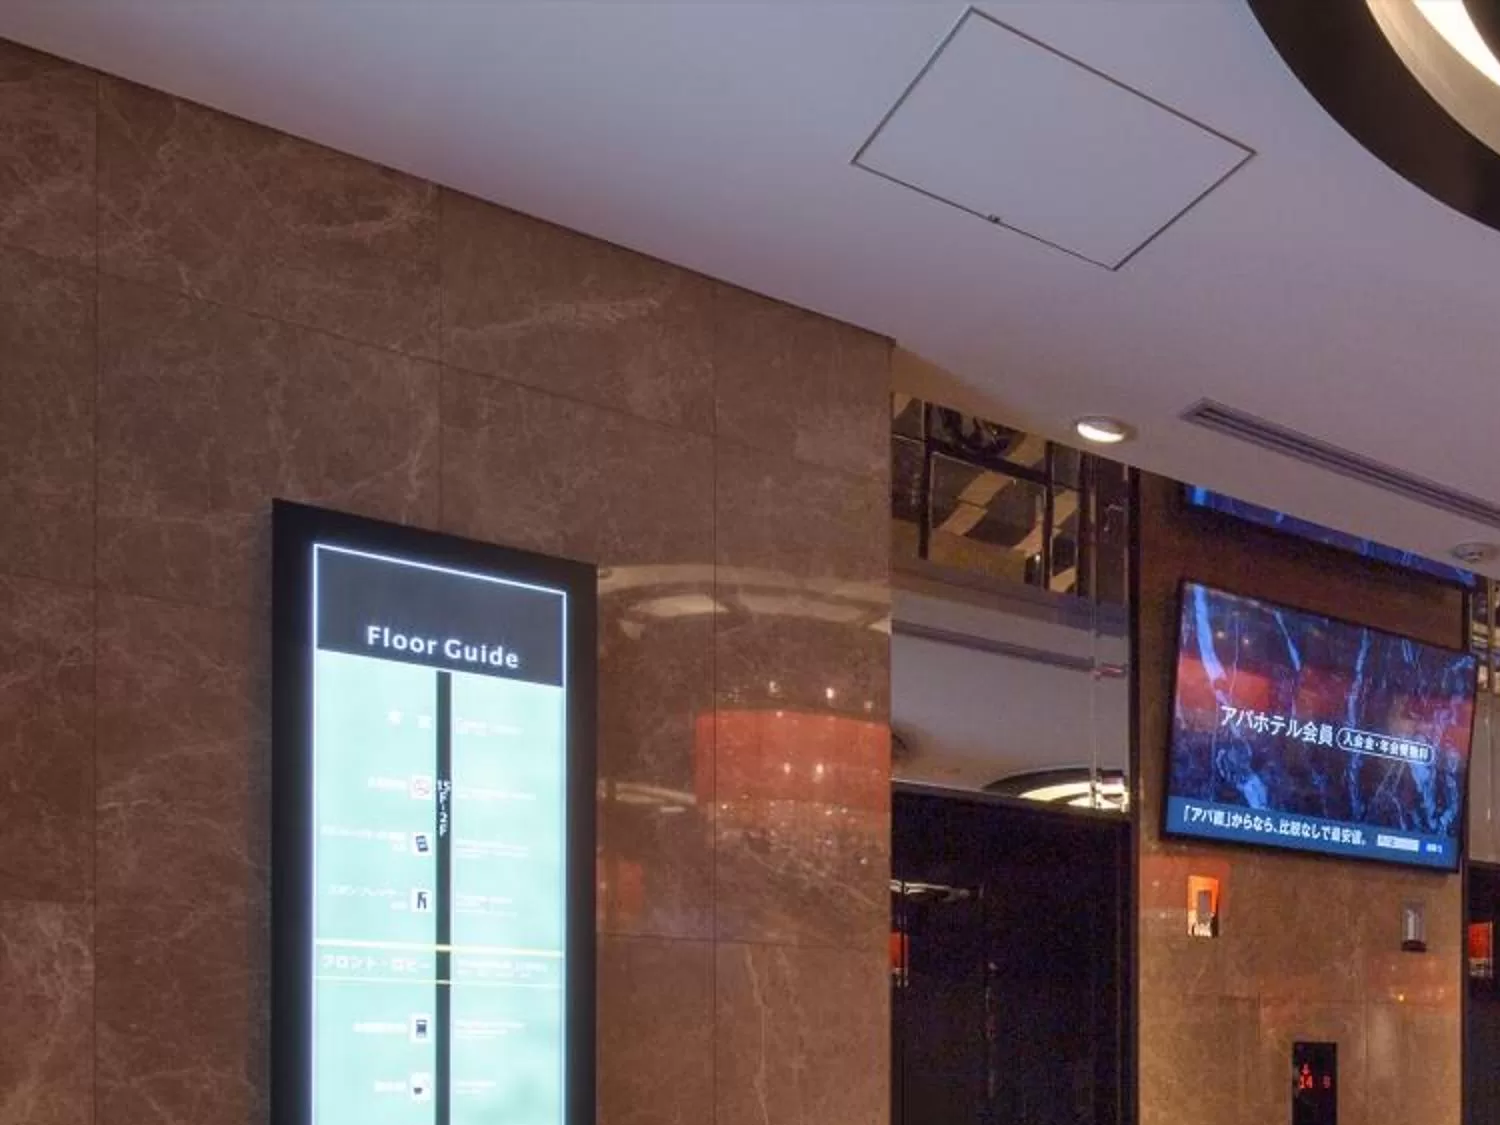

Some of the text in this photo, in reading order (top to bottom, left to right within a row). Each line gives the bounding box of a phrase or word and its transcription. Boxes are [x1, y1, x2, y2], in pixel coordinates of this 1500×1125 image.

[367, 625, 520, 669] Floor Guide
[1219, 705, 1333, 748] アパホテル会員
